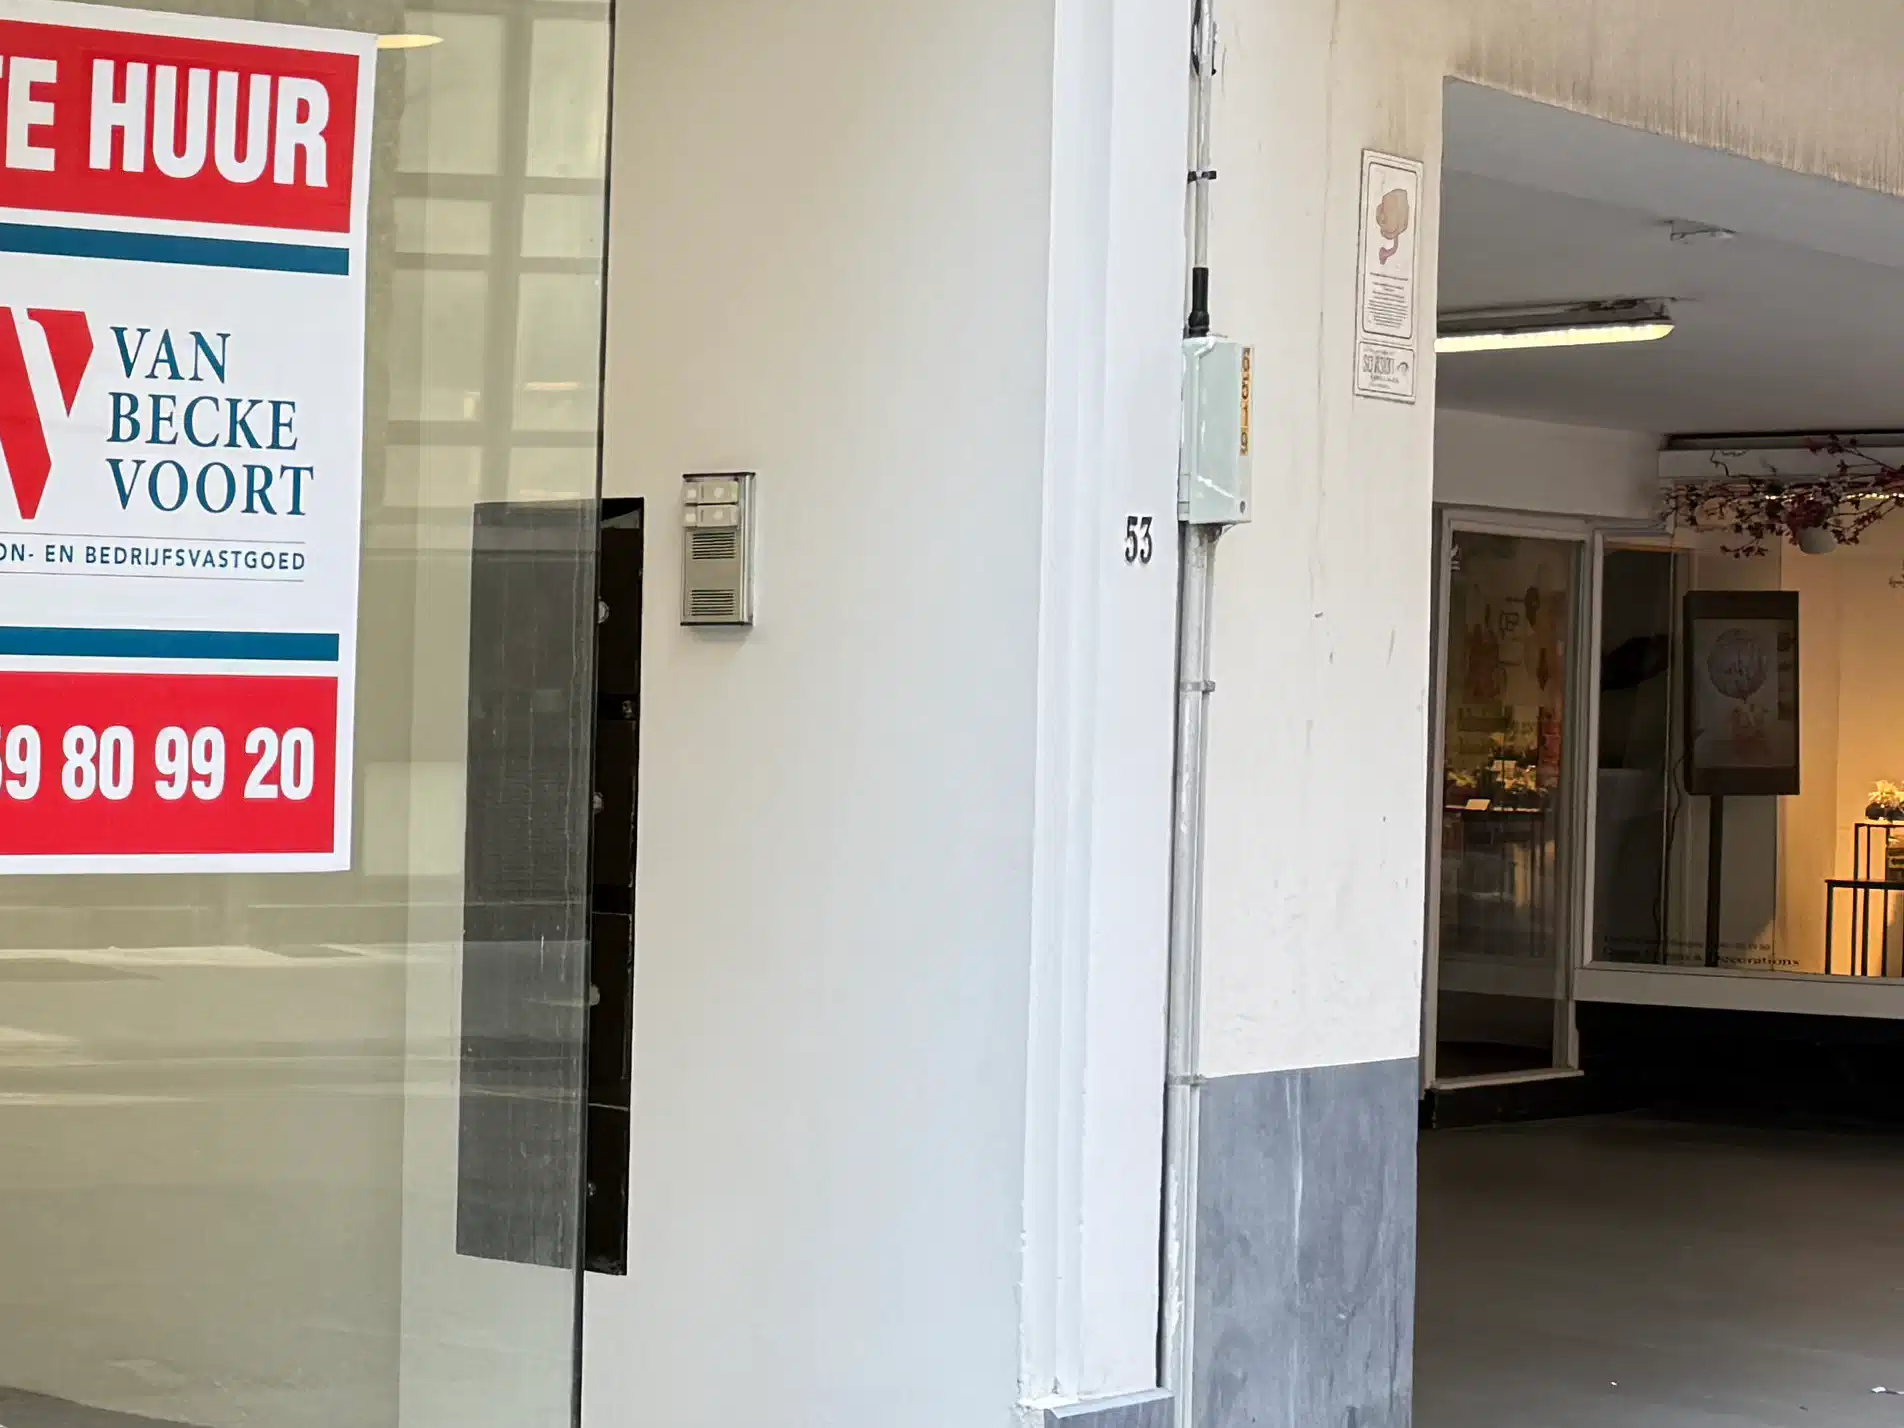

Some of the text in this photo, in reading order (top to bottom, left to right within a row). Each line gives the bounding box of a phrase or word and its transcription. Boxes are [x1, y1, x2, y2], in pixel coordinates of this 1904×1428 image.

[90, 58, 330, 188] HUUR
[110, 326, 231, 384] VAN
[106, 391, 298, 451] BECKE
[105, 459, 314, 516] VOORT
[45, 545, 74, 563] EN
[85, 545, 305, 570] BEDRIJFSVASTGOED
[1125, 515, 1153, 565] 53
[61, 725, 135, 801] 80
[154, 726, 226, 801] 99
[243, 727, 315, 801] 20
